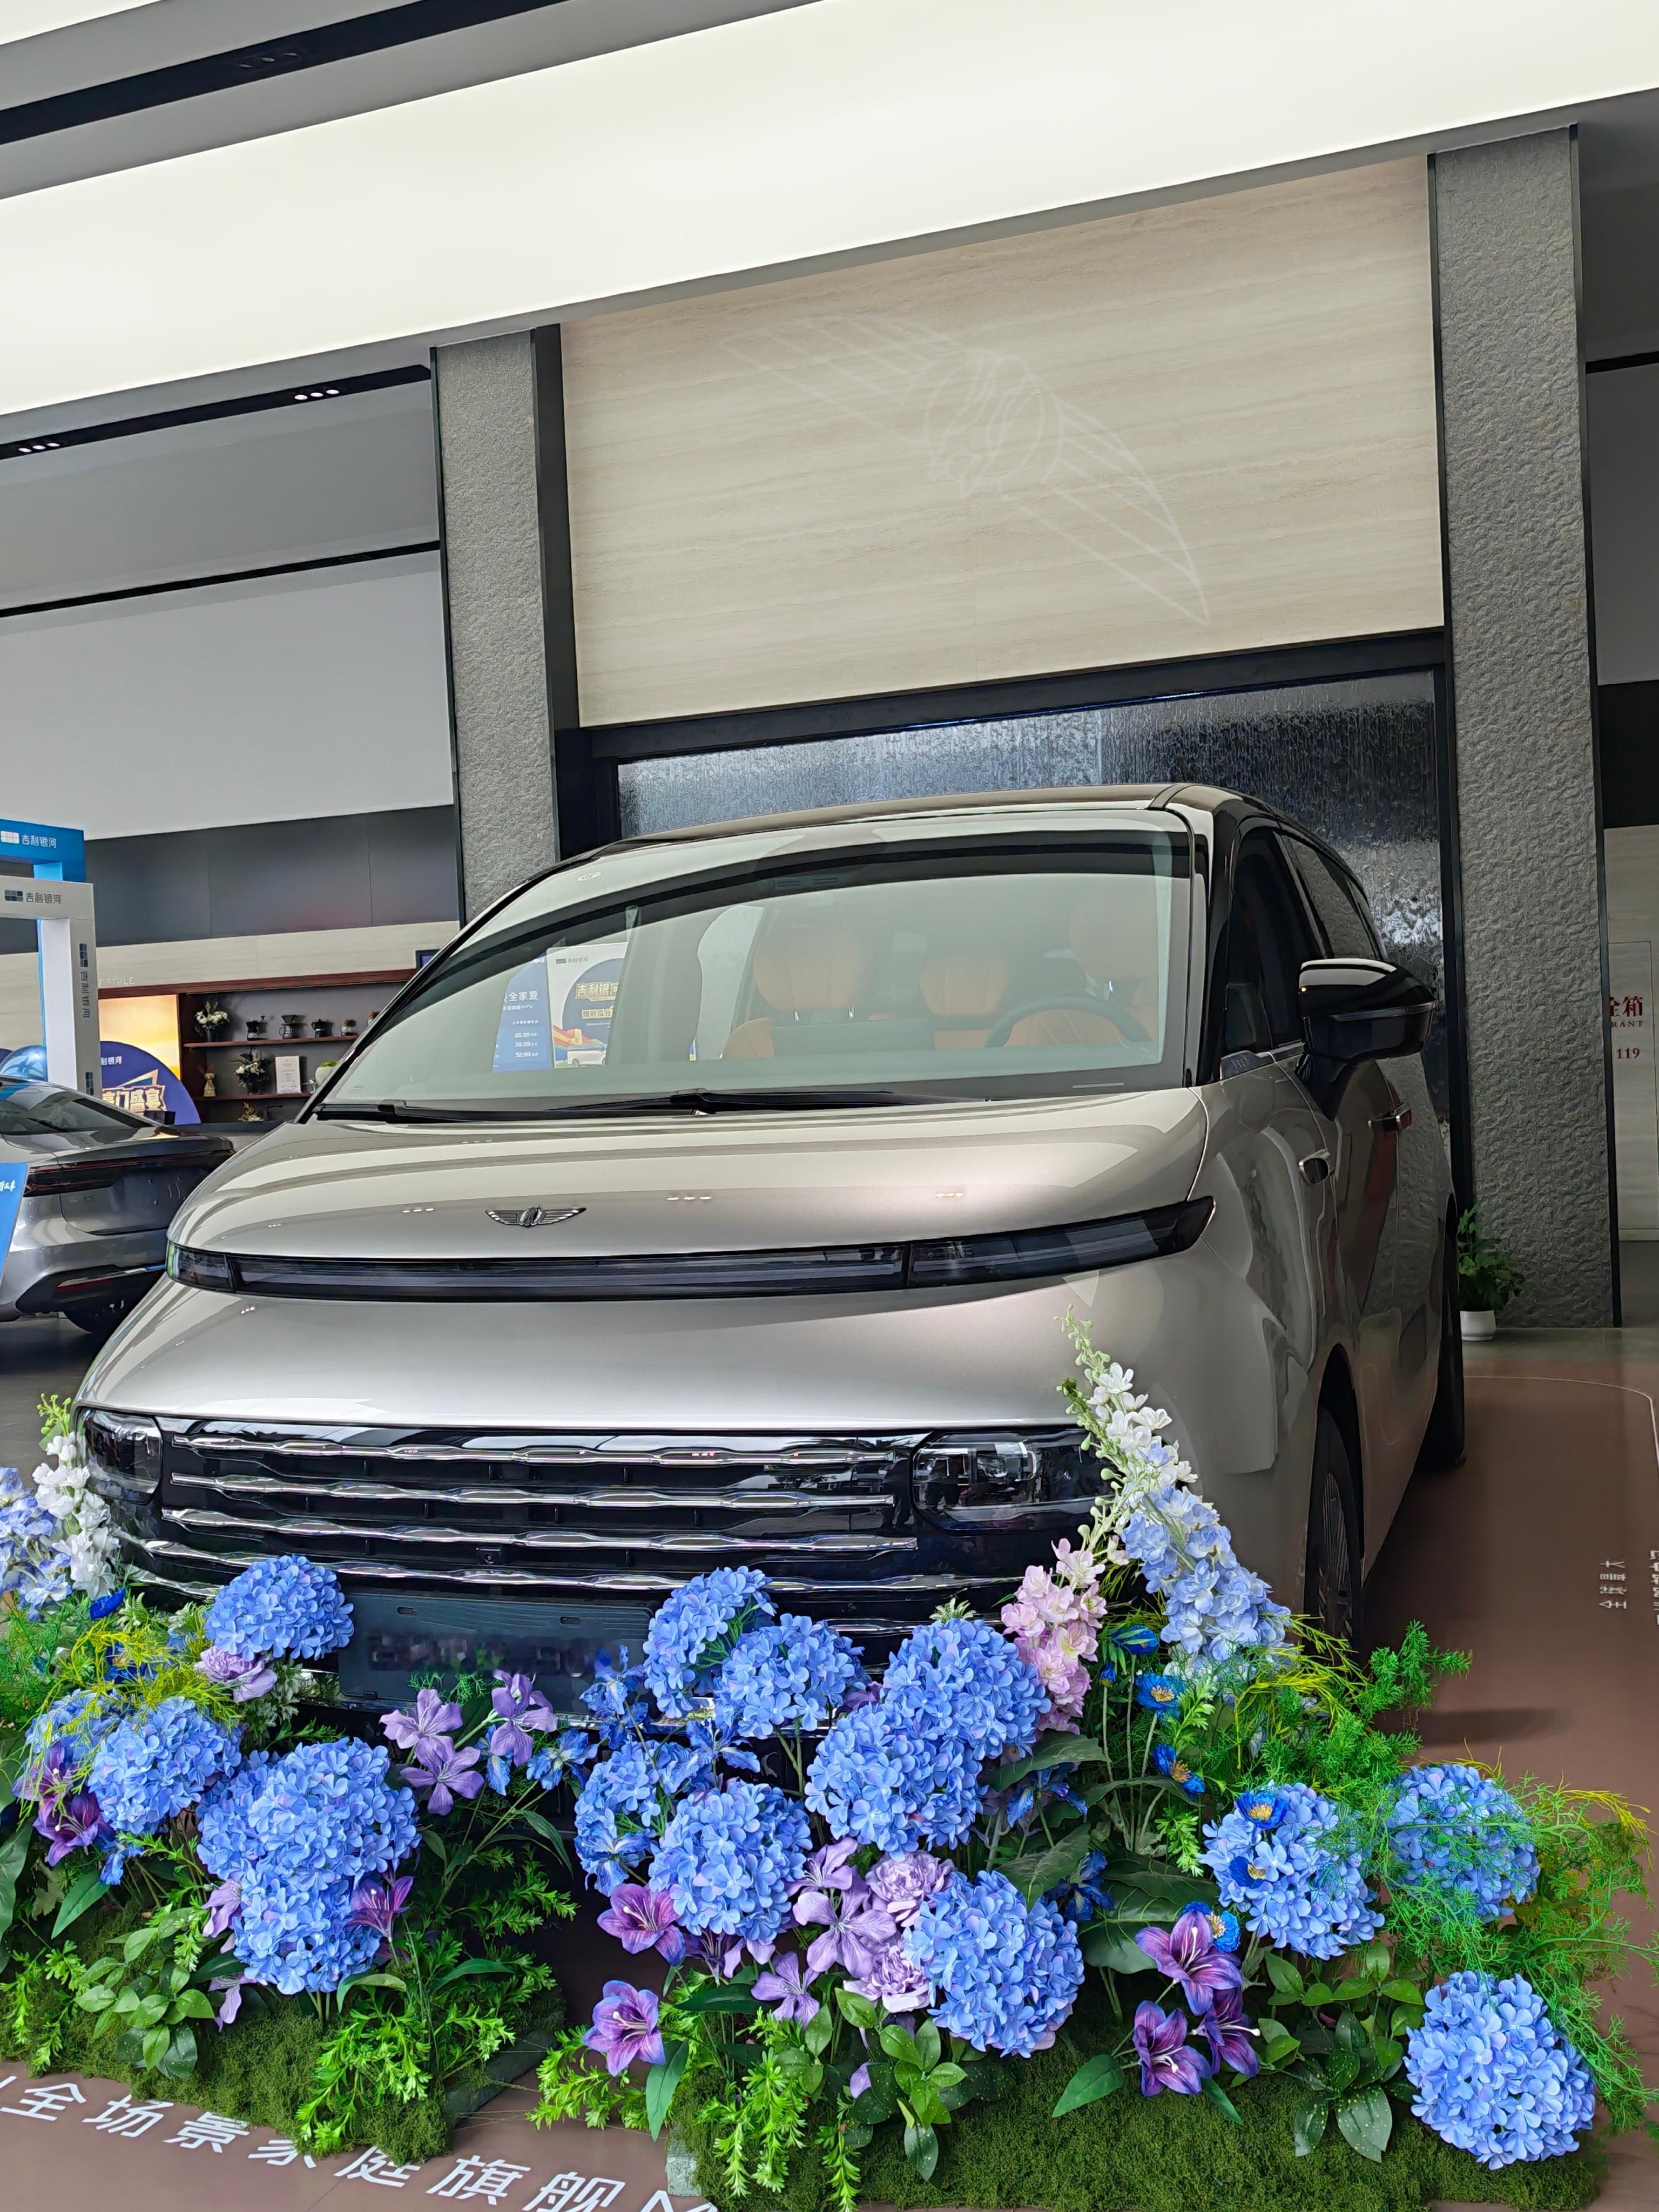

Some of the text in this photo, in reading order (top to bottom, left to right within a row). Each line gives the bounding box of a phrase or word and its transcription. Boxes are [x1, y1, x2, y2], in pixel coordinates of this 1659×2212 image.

[21, 834, 57, 848] 吉利银河
[25, 892, 61, 905] 吉利银河
[81, 972, 90, 1018] 吉利银河
[1616, 1048, 1640, 1059] 119
[1599, 1559, 1627, 1609] 全球最大
[0, 2076, 718, 2212] 全场景家庭旗舰
